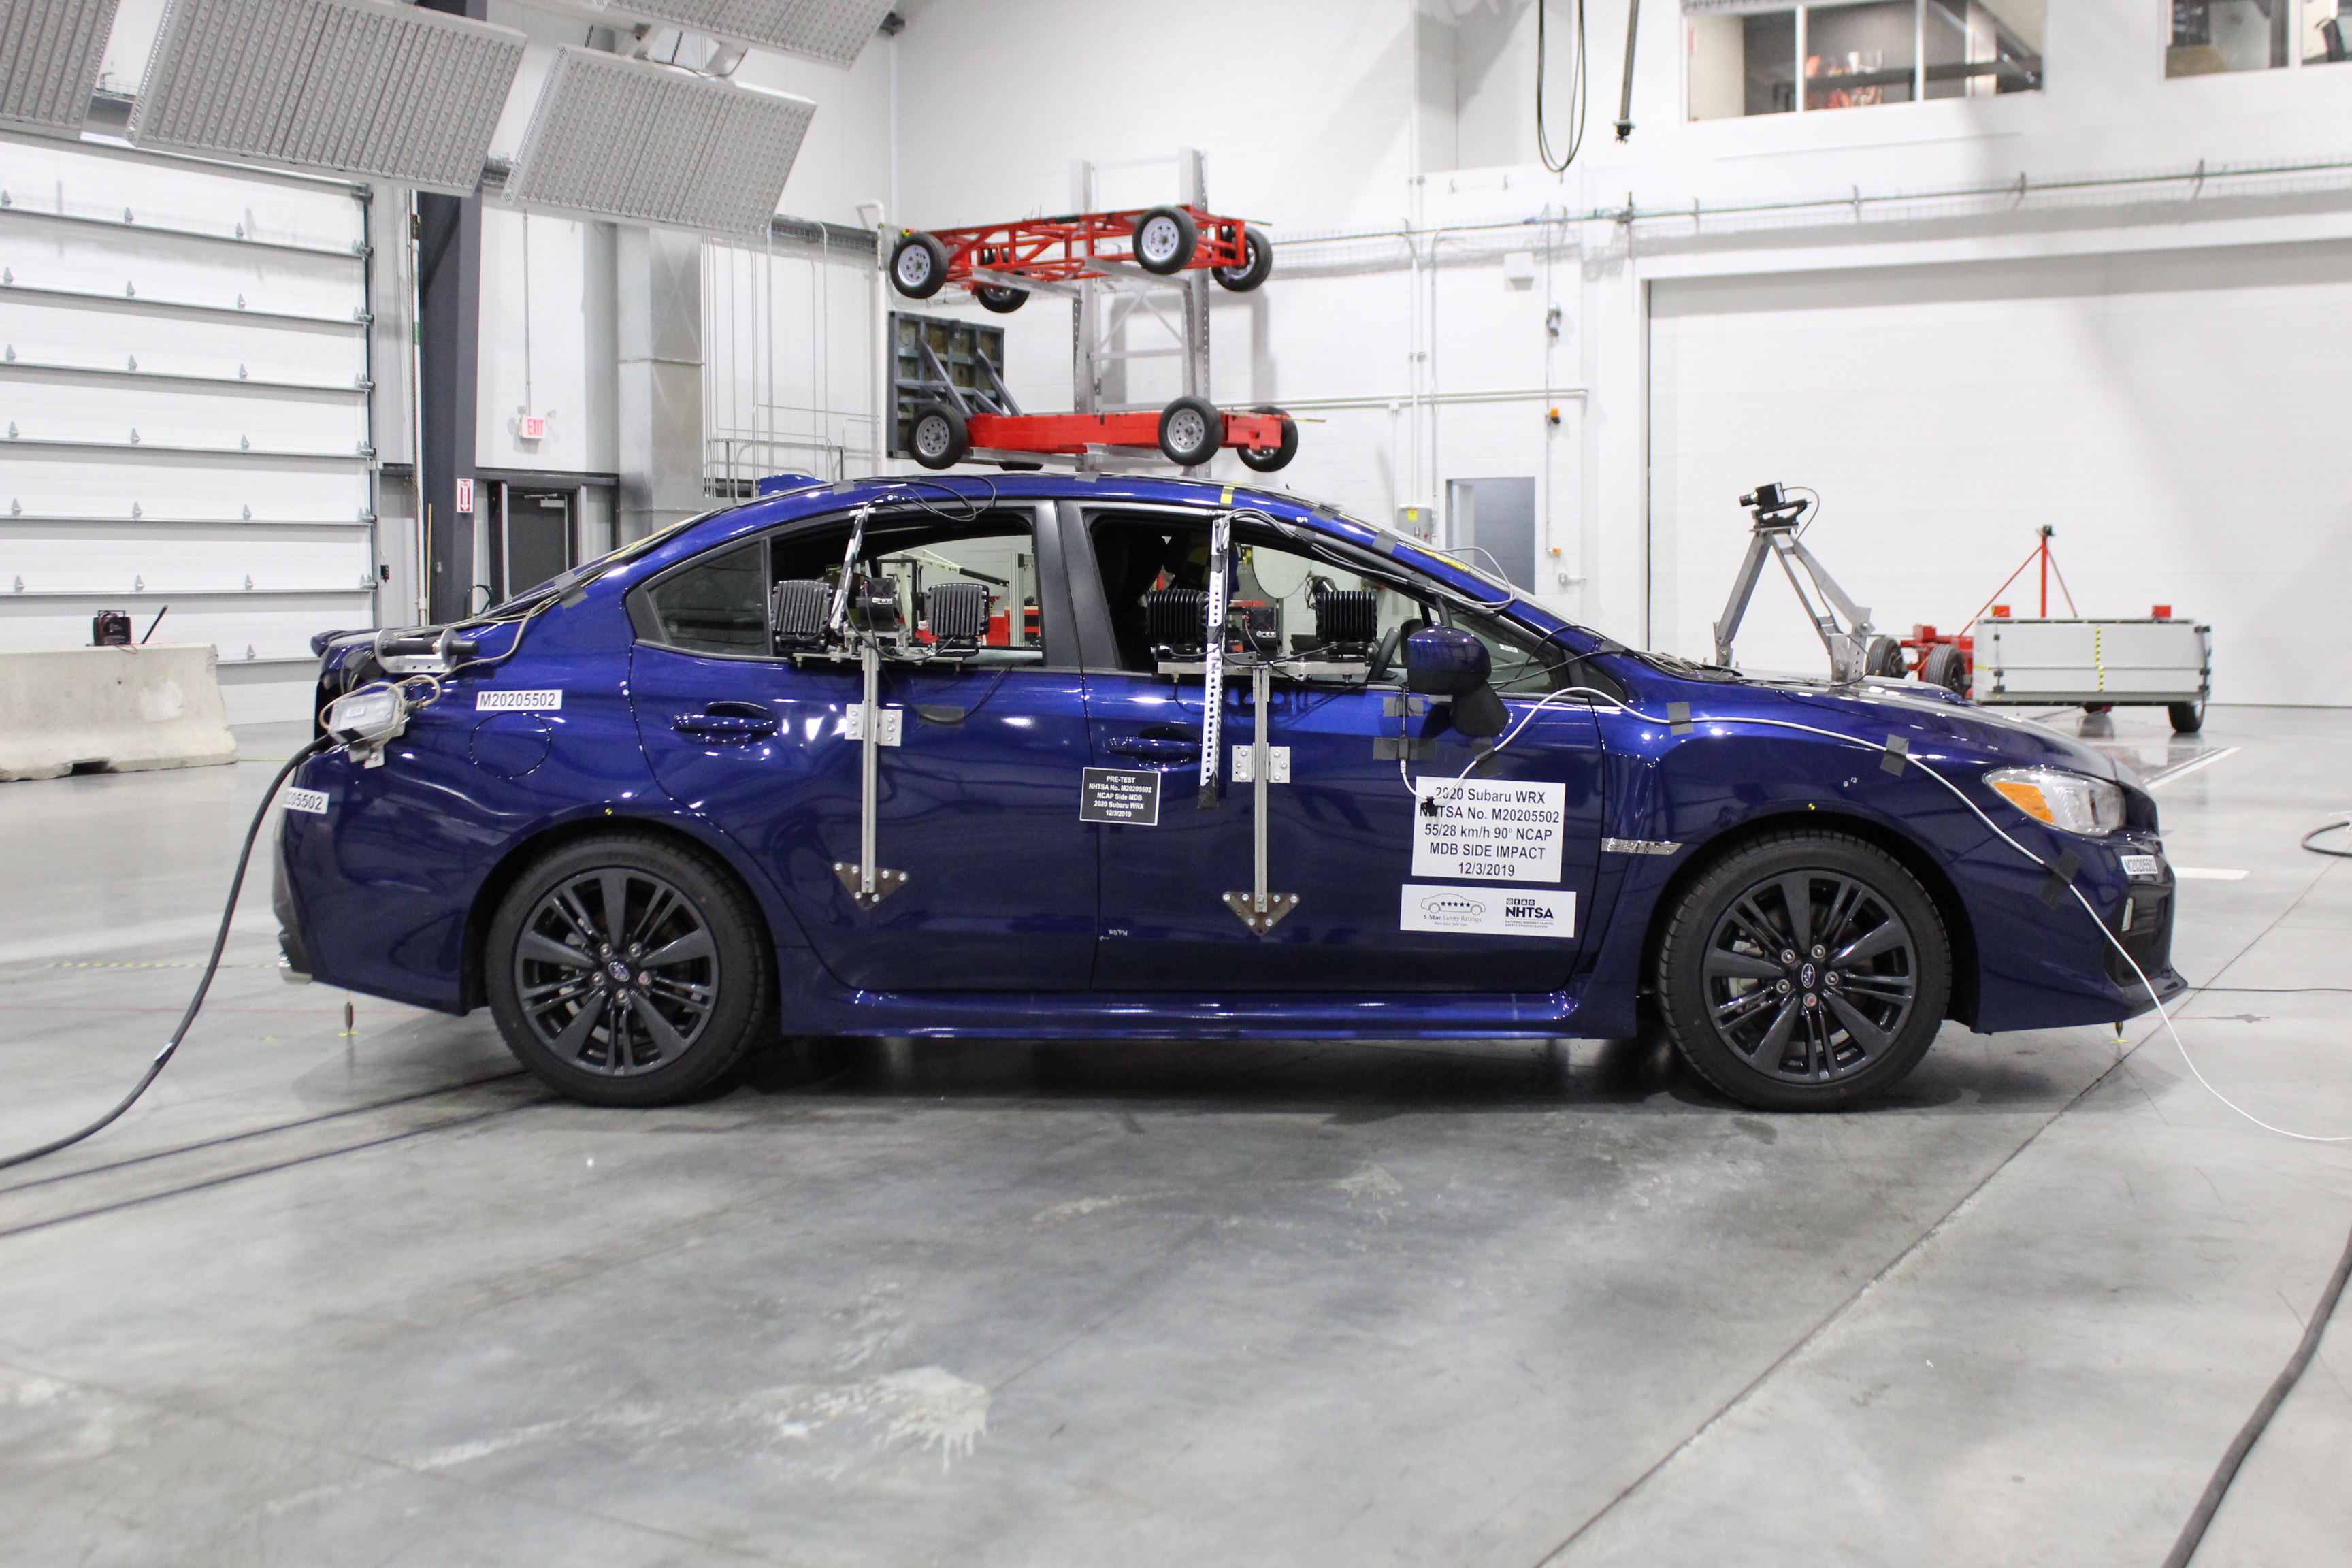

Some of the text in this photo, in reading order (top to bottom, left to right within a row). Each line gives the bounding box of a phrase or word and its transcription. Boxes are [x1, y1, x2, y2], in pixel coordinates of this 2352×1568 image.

[527, 419, 544, 436] EXIT
[479, 693, 555, 707] M20205502
[1106, 775, 1136, 783] PRE-TEST
[1435, 787, 1546, 804] 2020 Subaru WRX
[1105, 809, 1132, 817] 12/3/2019
[1420, 803, 1559, 823] NTSA No. M20205502
[1424, 823, 1456, 837] 55/28
[1460, 826, 1490, 838] km/h
[1516, 828, 1552, 841] NCAP
[1430, 842, 1546, 860] MDB SIDE IMPACT
[1458, 862, 1515, 877] 12/3/2019
[1505, 906, 1554, 919] NHTSA
